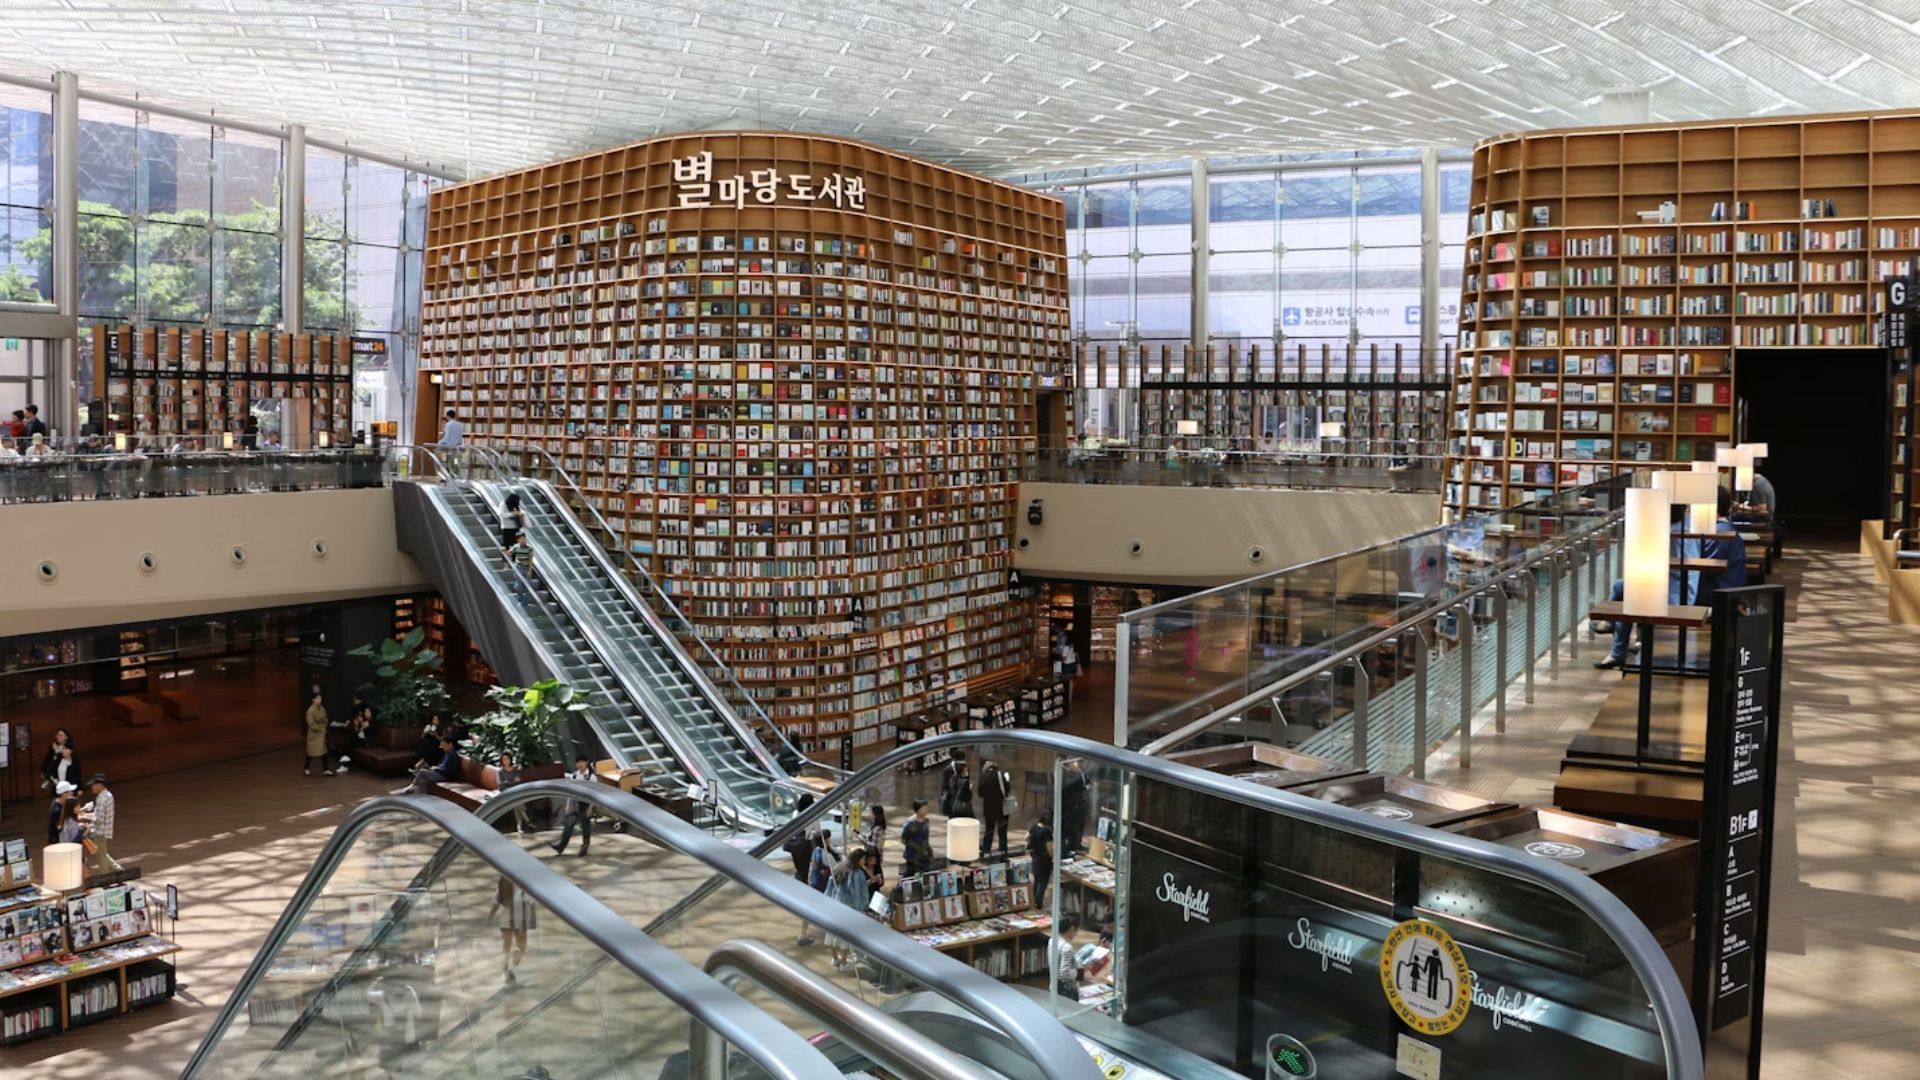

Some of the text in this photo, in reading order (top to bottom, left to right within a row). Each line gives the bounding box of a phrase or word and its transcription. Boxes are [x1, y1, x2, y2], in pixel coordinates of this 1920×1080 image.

[786, 173, 867, 209] 도서관
[1891, 282, 1905, 305] G
[111, 336, 117, 349] E
[352, 341, 385, 352] mart24
[1010, 571, 1019, 582] A
[855, 599, 863, 611] A
[1740, 647, 1750, 666] 1F
[1729, 814, 1748, 836] B1F
[1728, 846, 1734, 858] A
[1156, 872, 1209, 922] Starfield
[1724, 923, 1729, 935] C
[1288, 917, 1353, 972] Starfield
[1722, 962, 1727, 974] D
[1469, 969, 1533, 1030] tarfiel
